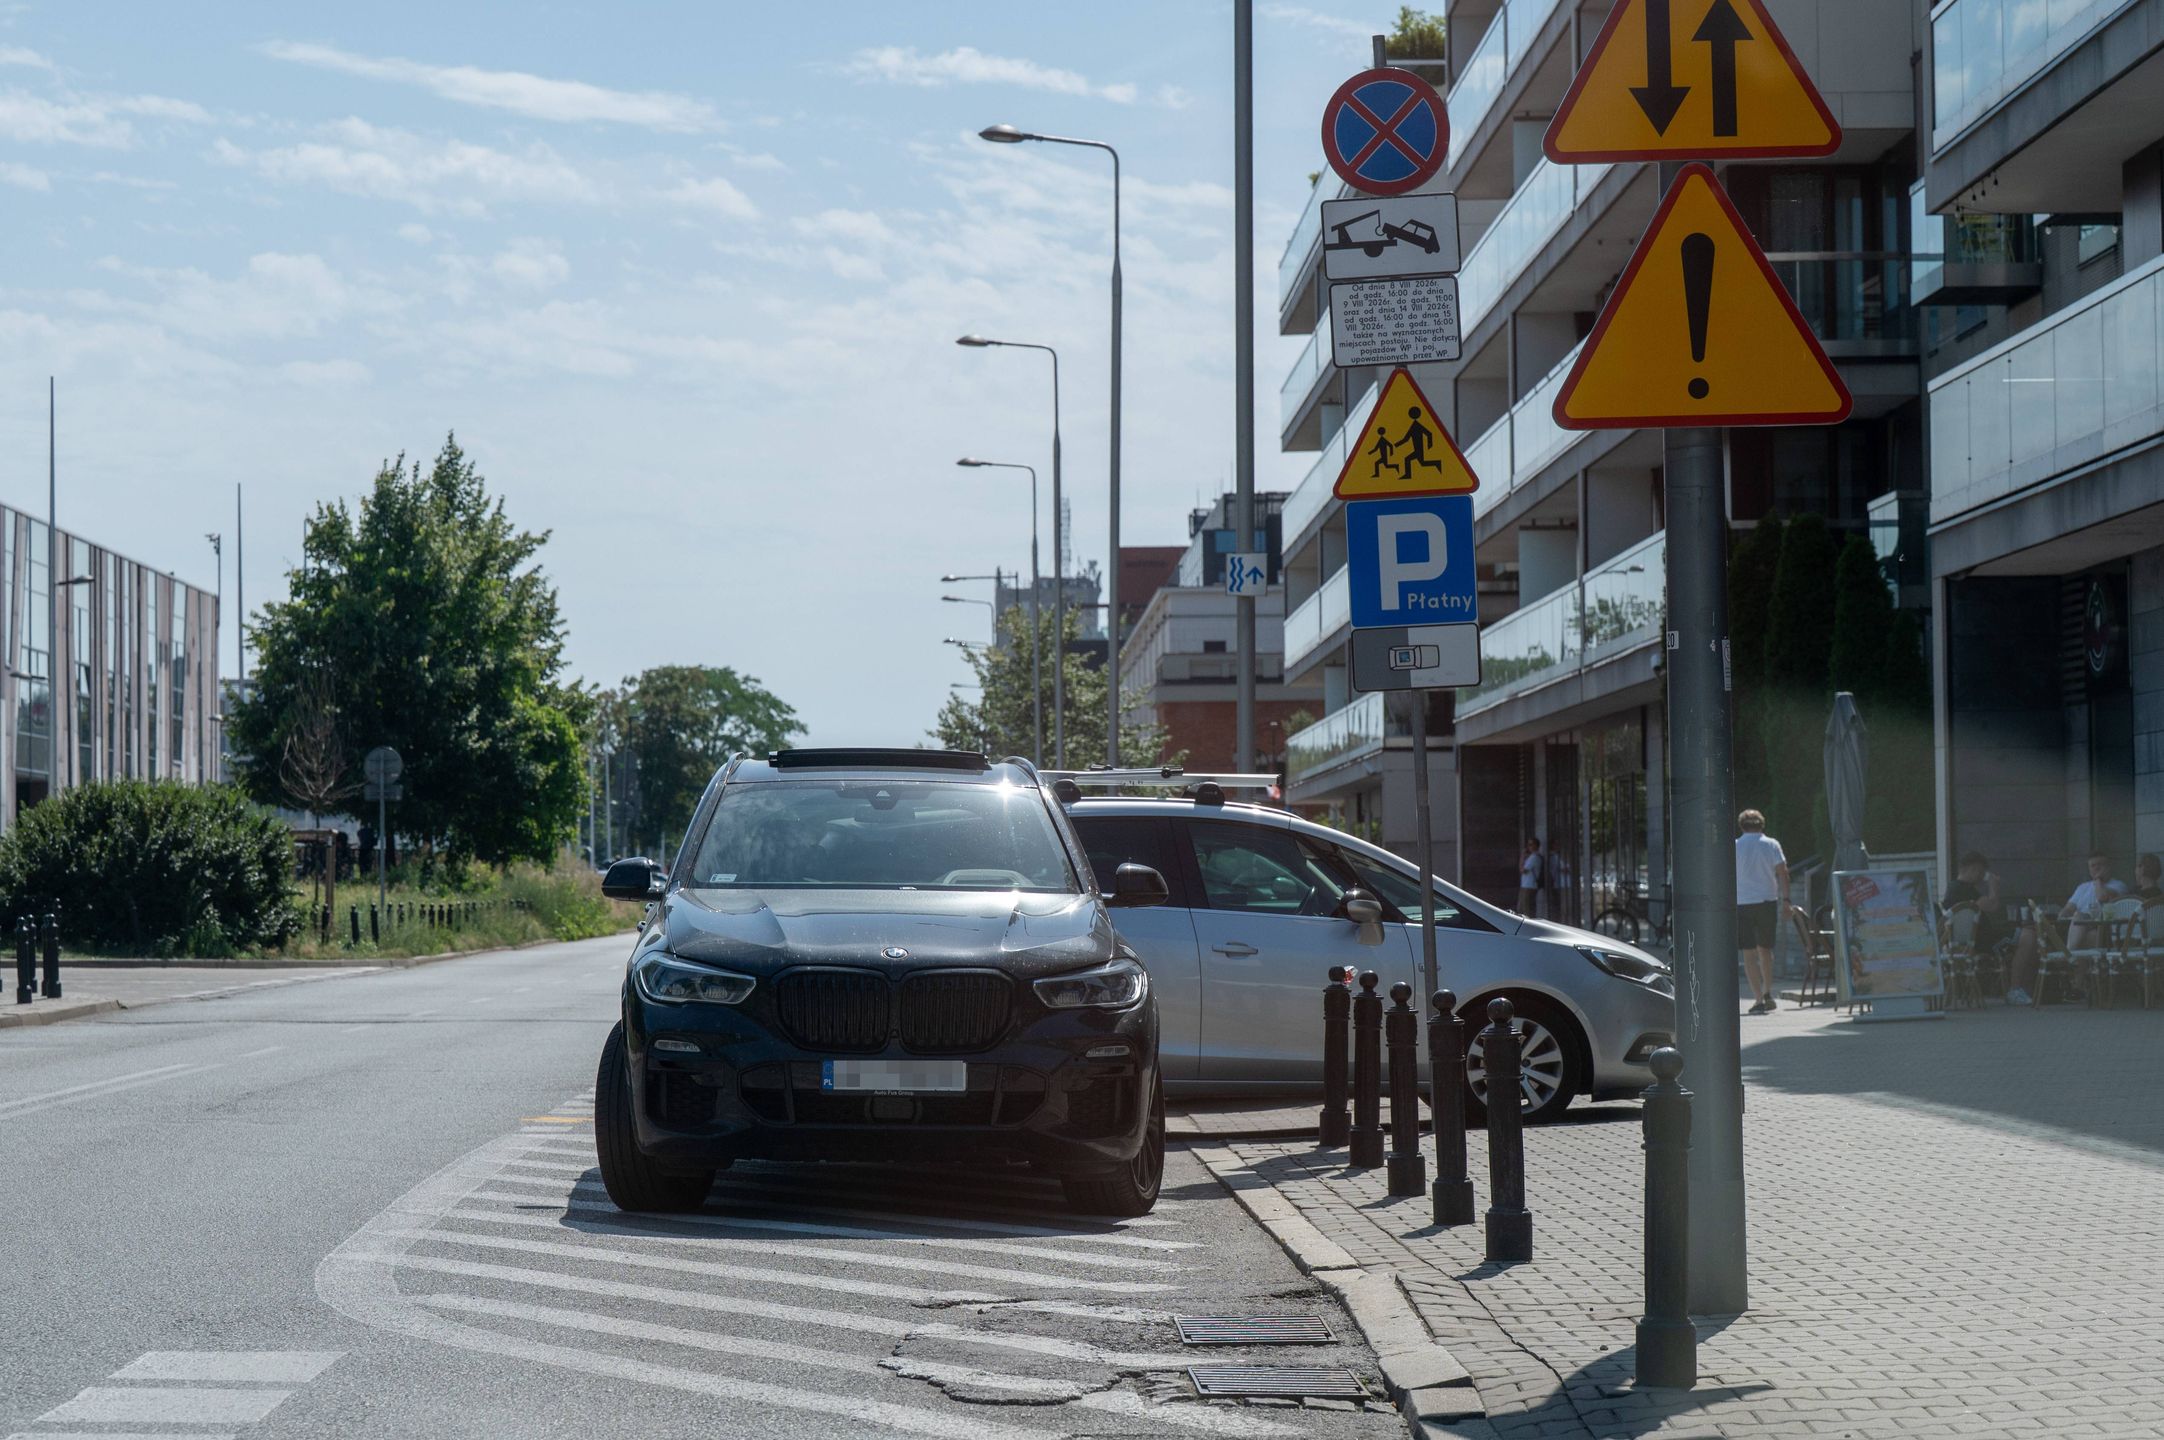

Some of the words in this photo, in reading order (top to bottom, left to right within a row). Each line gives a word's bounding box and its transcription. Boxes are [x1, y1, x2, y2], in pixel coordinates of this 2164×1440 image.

[1364, 291, 1383, 300] godz.
[1411, 297, 1431, 305] godz.
[1384, 313, 1403, 321] 16:00
[1409, 321, 1429, 329] godz.
[1392, 327, 1444, 337] wyznaczonych
[1339, 340, 1376, 348] miejscach
[1381, 337, 1410, 346] postoju.
[1423, 343, 1436, 351] poj.
[1413, 352, 1432, 360] przez
[1377, 512, 1448, 611] P
[1408, 592, 1473, 613] Płatny
